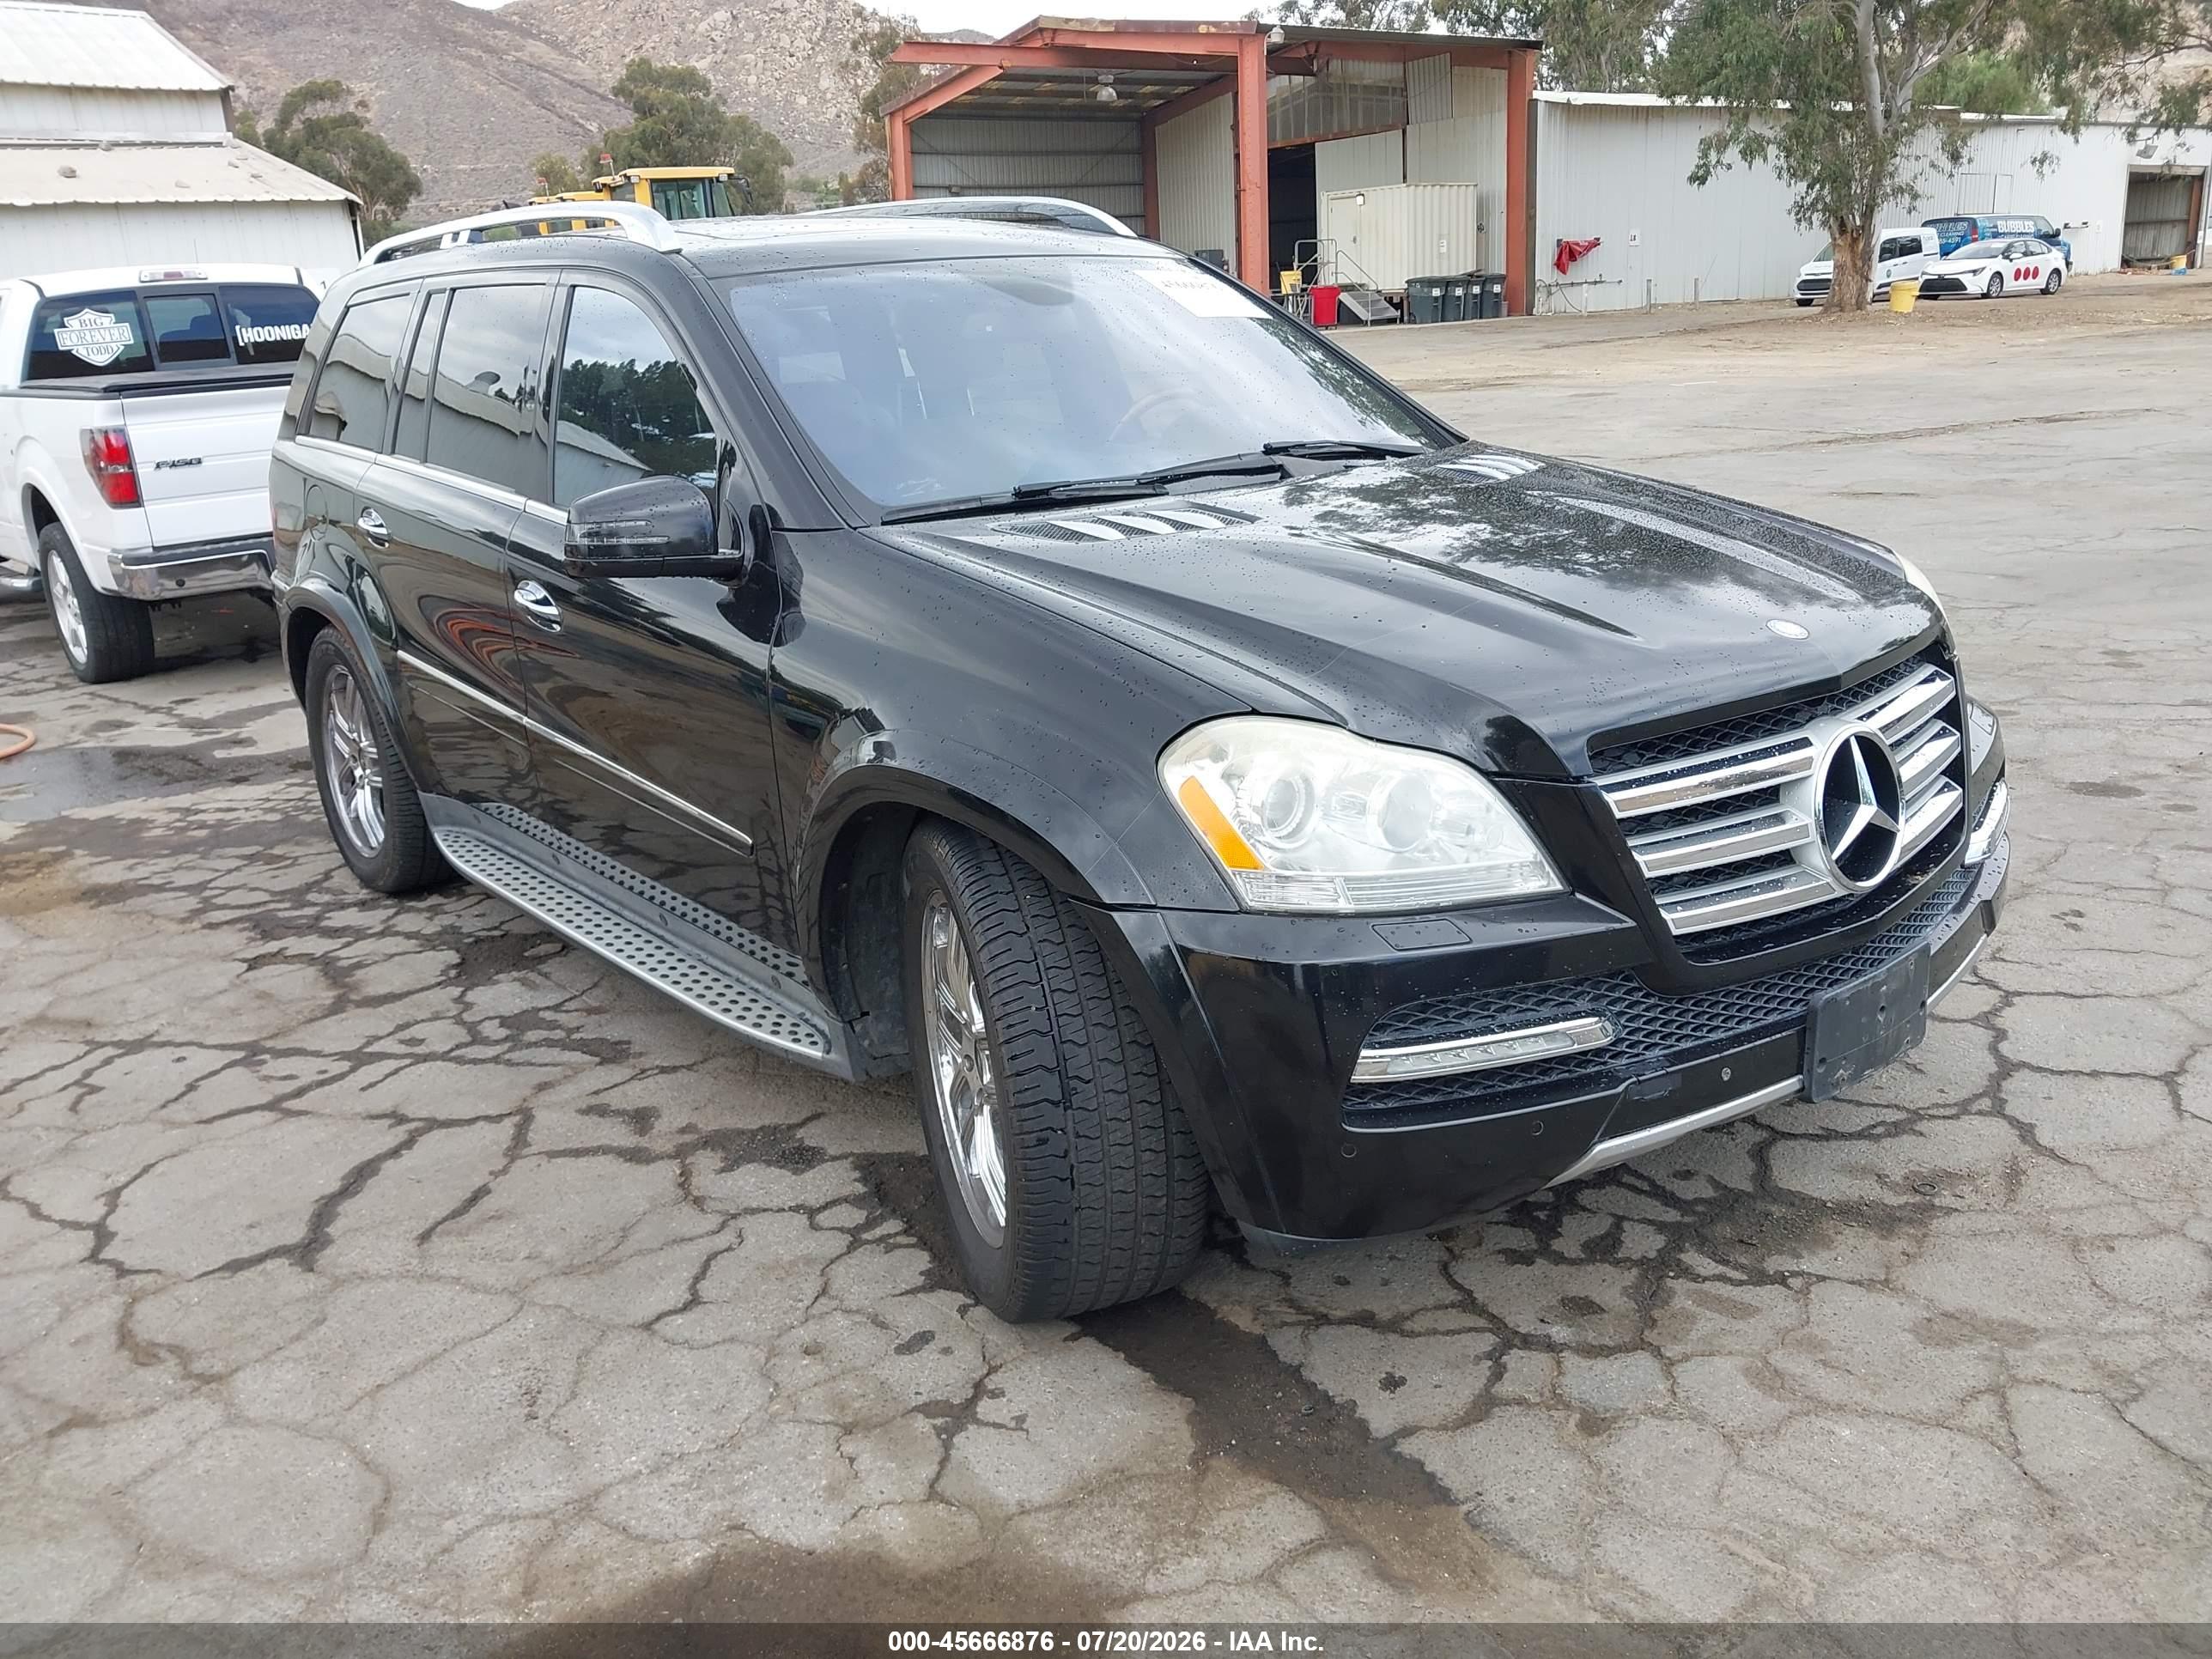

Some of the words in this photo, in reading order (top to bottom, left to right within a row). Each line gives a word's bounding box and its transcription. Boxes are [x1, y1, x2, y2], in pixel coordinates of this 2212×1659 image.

[1996, 220, 2034, 233] BUBBLES
[79, 316, 103, 328] BIG
[60, 327, 128, 344] FOREVER
[85, 344, 114, 356] TODD
